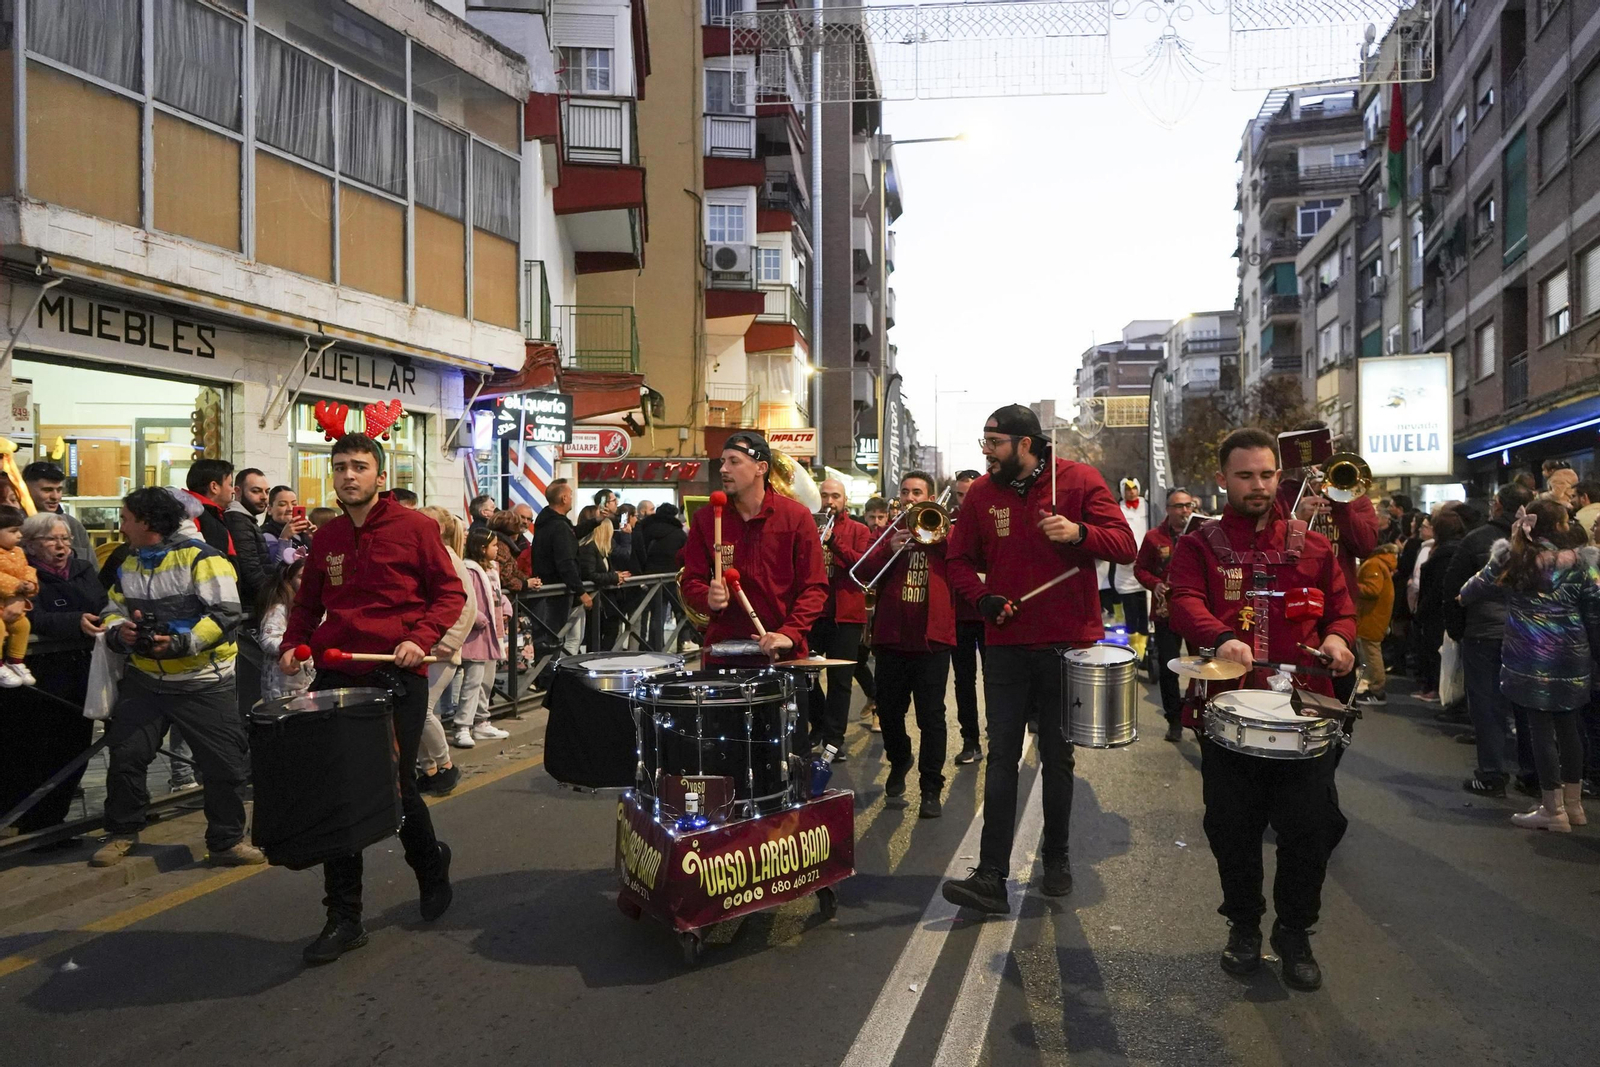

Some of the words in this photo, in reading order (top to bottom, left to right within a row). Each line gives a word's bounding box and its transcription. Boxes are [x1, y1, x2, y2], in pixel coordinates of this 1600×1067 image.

[38, 294, 216, 359] MUEBLES
[496, 393, 566, 415] Peluquería
[525, 424, 566, 442] Sultán
[770, 433, 814, 442] IMPACTO
[1368, 433, 1440, 453] VIVELA
[579, 462, 701, 480] MPACTO
[905, 570, 929, 586] ARGO
[902, 586, 926, 602] BAND
[748, 835, 800, 884] LARGO
[799, 824, 831, 868] BAND
[771, 879, 792, 894] 680
[793, 874, 807, 889] 460
[807, 868, 820, 884] 271
